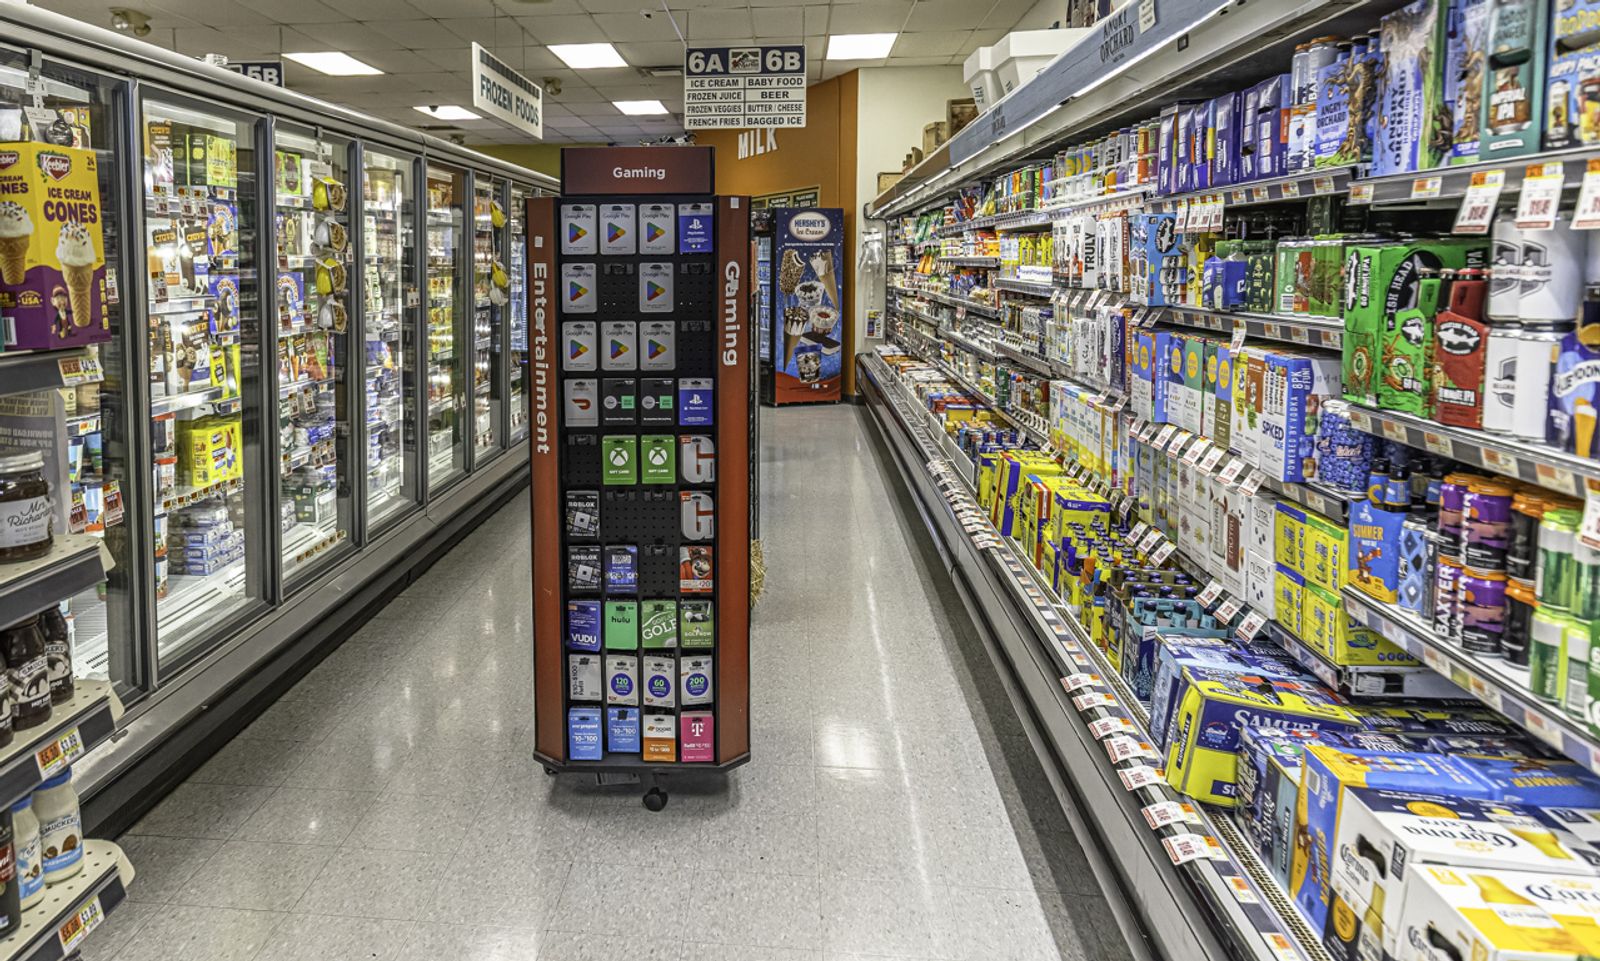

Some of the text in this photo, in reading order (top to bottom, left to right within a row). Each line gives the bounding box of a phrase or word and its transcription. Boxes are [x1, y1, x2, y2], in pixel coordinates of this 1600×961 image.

[1100, 24, 1134, 63] ORCHARD
[688, 51, 724, 73] 6A
[765, 49, 801, 72] 6B
[690, 78, 739, 88] ICE CREAM
[748, 77, 803, 87] BABY FOOD
[480, 73, 539, 127] FROZEN FOODS
[687, 91, 742, 100] FROZEN JUICE
[760, 91, 790, 99] BEER
[687, 104, 742, 114] FROZEN VEGGIES
[747, 104, 772, 113] BUTTER
[777, 103, 802, 112] CHEESE
[1395, 69, 1406, 166] ORCHARD
[688, 117, 741, 126] FRENCH FRIES
[747, 116, 802, 125] BAGGED ICE
[1388, 88, 1398, 152] ANGRY
[738, 128, 778, 160] MILK
[41, 154, 70, 173] Keebler
[612, 166, 666, 180] Gaming
[48, 187, 92, 201] ICE CREAM
[43, 200, 98, 224] CONES
[794, 219, 826, 228] HERSHEY'S
[1084, 232, 1096, 272] TRULY
[1467, 250, 1483, 268] IPA
[1393, 260, 1413, 292] HEAD
[21, 296, 40, 305] USA
[722, 261, 740, 367] Gaming
[533, 263, 550, 454] Entertainment
[1291, 370, 1304, 390] 8PK
[1262, 420, 1285, 441] SPIKED
[1286, 396, 1299, 476] POWERED BY VODKA
[1353, 524, 1384, 541] SUMMER
[1435, 565, 1455, 637] BAXTER
[611, 616, 631, 624] hulu
[642, 619, 677, 640] GOLF
[571, 633, 597, 644] VUDU
[615, 677, 628, 685] 120
[654, 679, 665, 687] 60
[689, 676, 705, 685] 200
[1233, 709, 1321, 732] SAMUEL
[1177, 719, 1191, 765] SUMMER ALE
[1402, 825, 1518, 848] Corona
[1340, 843, 1370, 882] Corona
